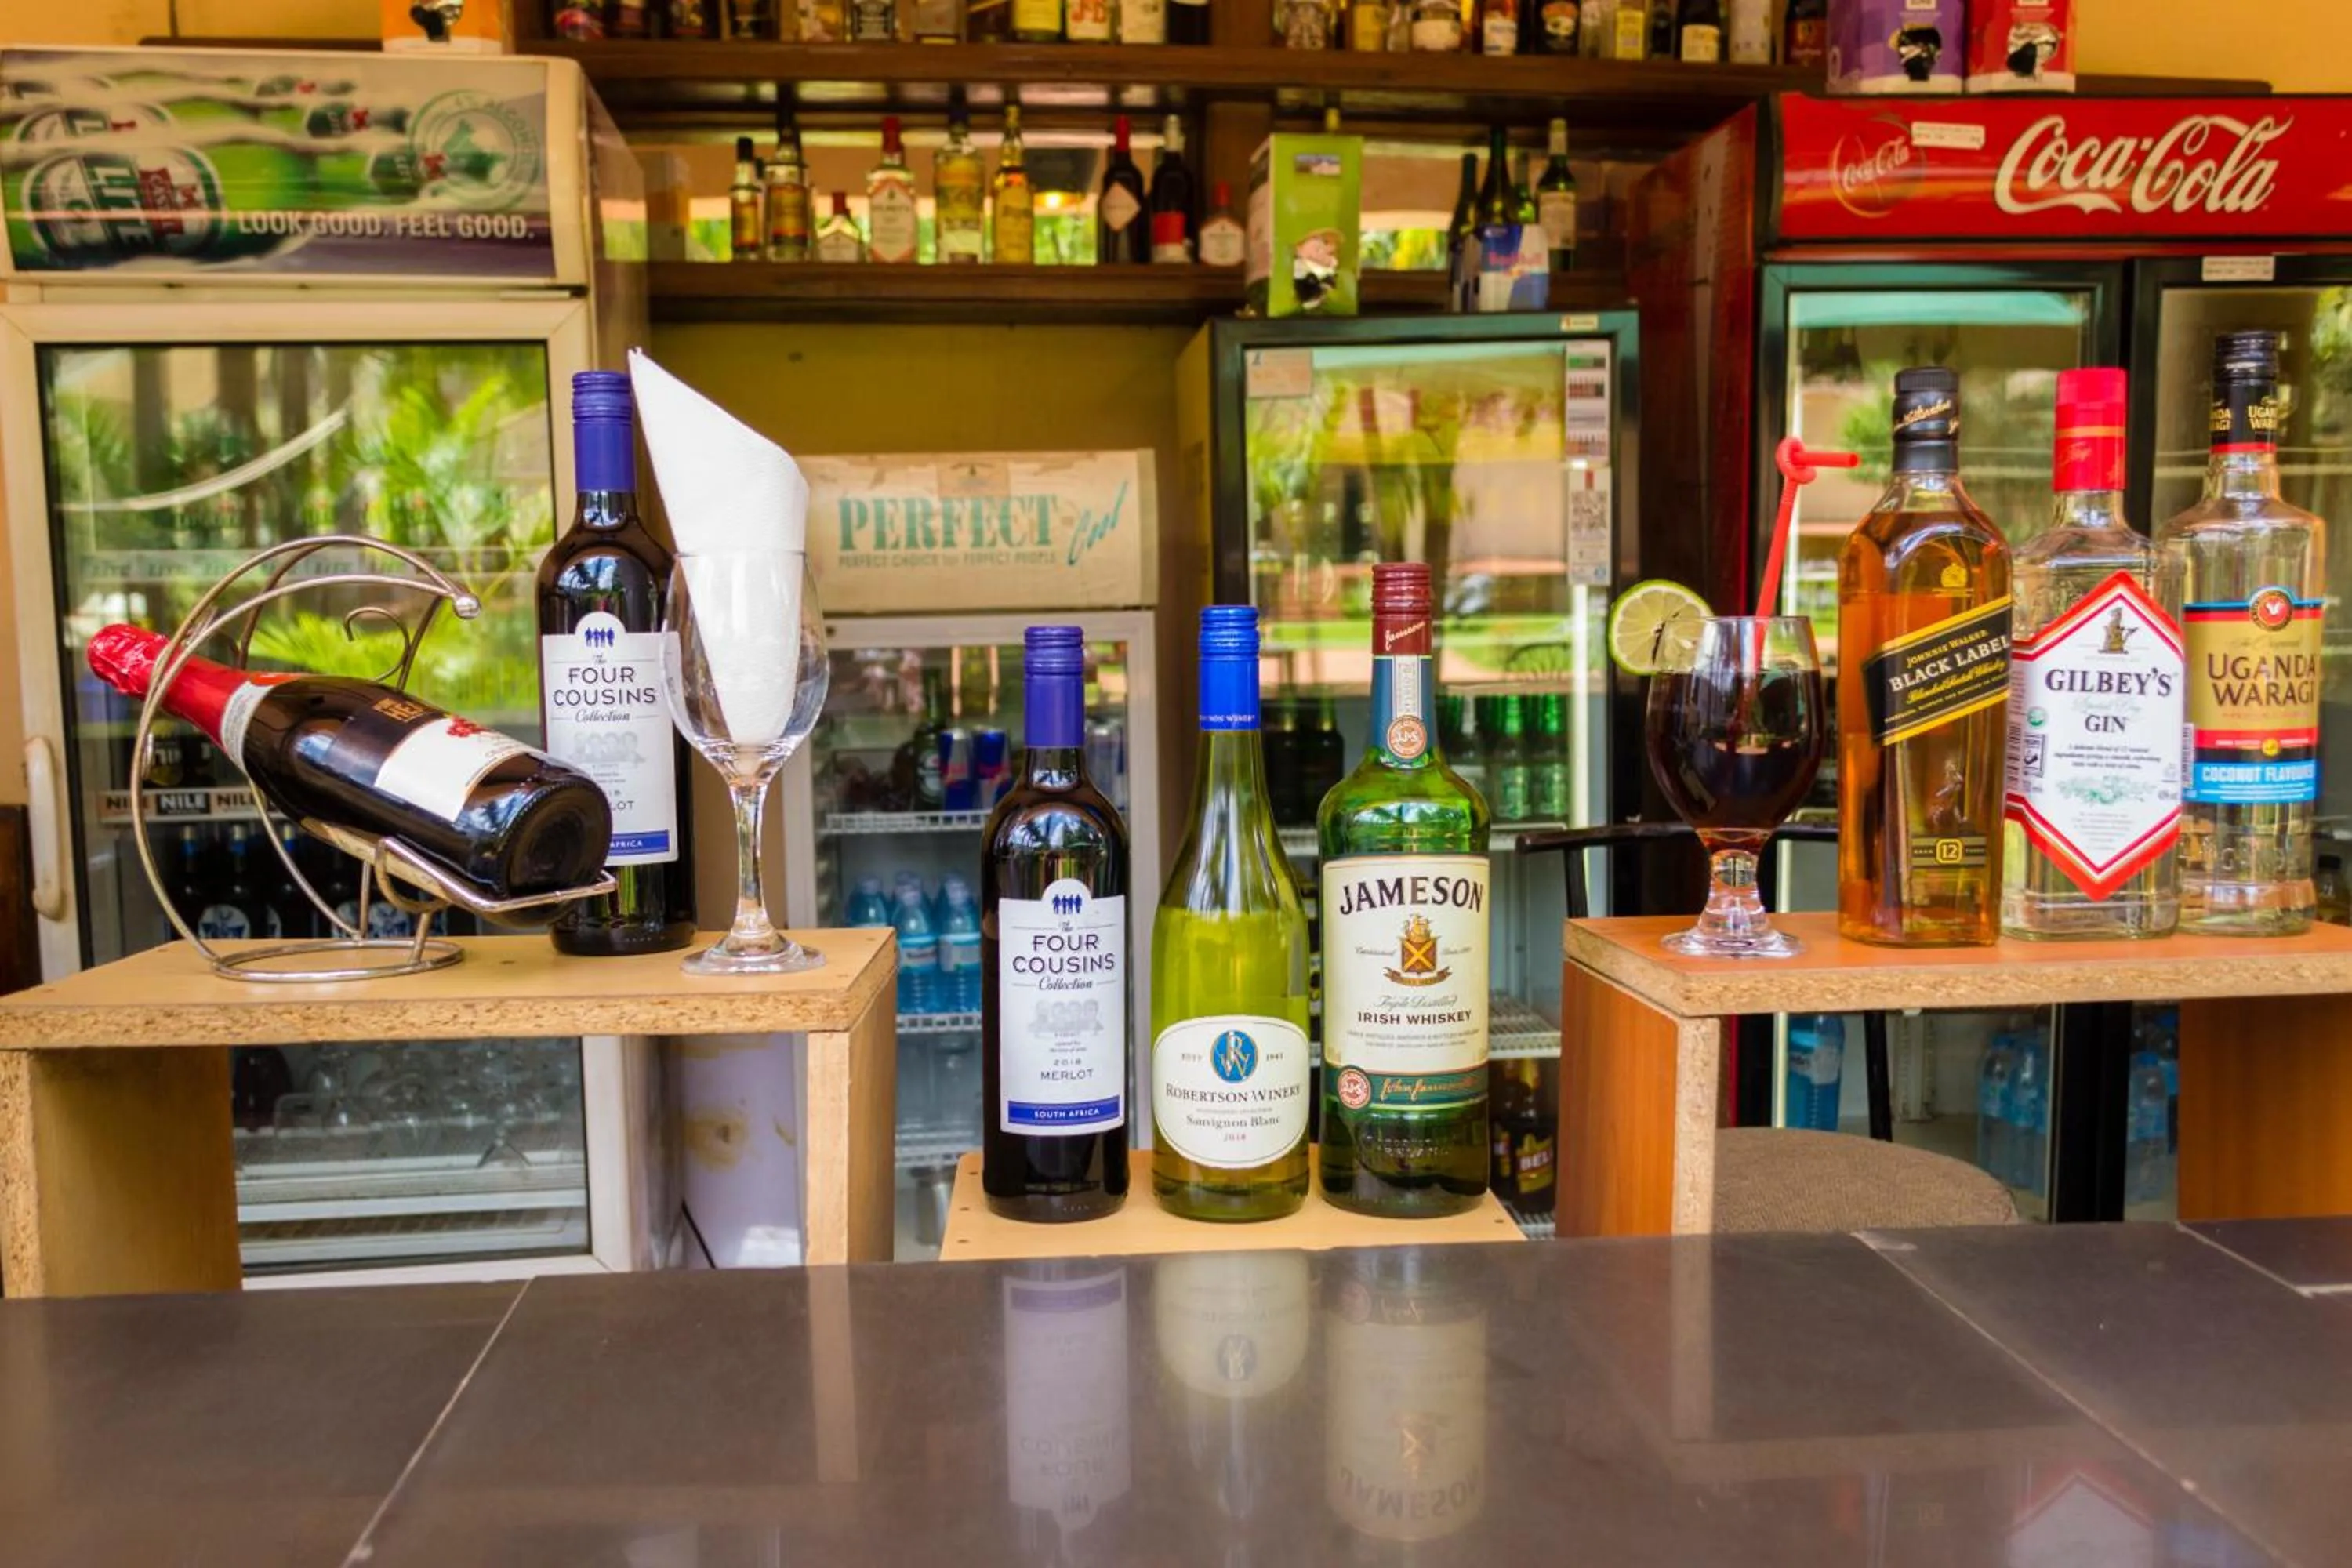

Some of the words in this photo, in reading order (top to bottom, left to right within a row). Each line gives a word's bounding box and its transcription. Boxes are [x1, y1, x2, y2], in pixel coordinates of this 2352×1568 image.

[238, 212, 305, 234] LOOK
[312, 212, 390, 237] GOOD.
[395, 213, 451, 238] FEEL
[458, 214, 535, 239] GOOD.
[838, 494, 1058, 551] PERFECT
[1906, 644, 1948, 668] JOHNNIE
[1949, 630, 1989, 649] WALKER
[1888, 658, 1952, 692] BLACK
[1954, 634, 2012, 667] LABEL
[2207, 652, 2316, 681] UGANDA
[568, 666, 635, 684] FOUR
[2045, 666, 2172, 698] GILBEY'S
[553, 687, 657, 706] COUSINS
[2212, 681, 2314, 707] WARAGI
[575, 708, 631, 724] Collection
[2084, 713, 2128, 734] GIN
[2201, 766, 2262, 782] COCONUT
[159, 793, 206, 810] NILE
[612, 800, 635, 811] LOT
[1940, 844, 1958, 859] 12
[1340, 876, 1484, 916] JAMESON
[1032, 933, 1100, 952] FOUR
[1012, 953, 1116, 974] COUSINS
[1038, 976, 1093, 991] Collection
[1357, 1011, 1400, 1025] IRISH
[1406, 1010, 1472, 1025] WHISKEY
[1040, 1069, 1094, 1081] MERLOT
[1166, 1083, 1248, 1102] ROBERTSON
[1033, 1110, 1065, 1119] SOUTH
[1068, 1109, 1100, 1118] AFRICA
